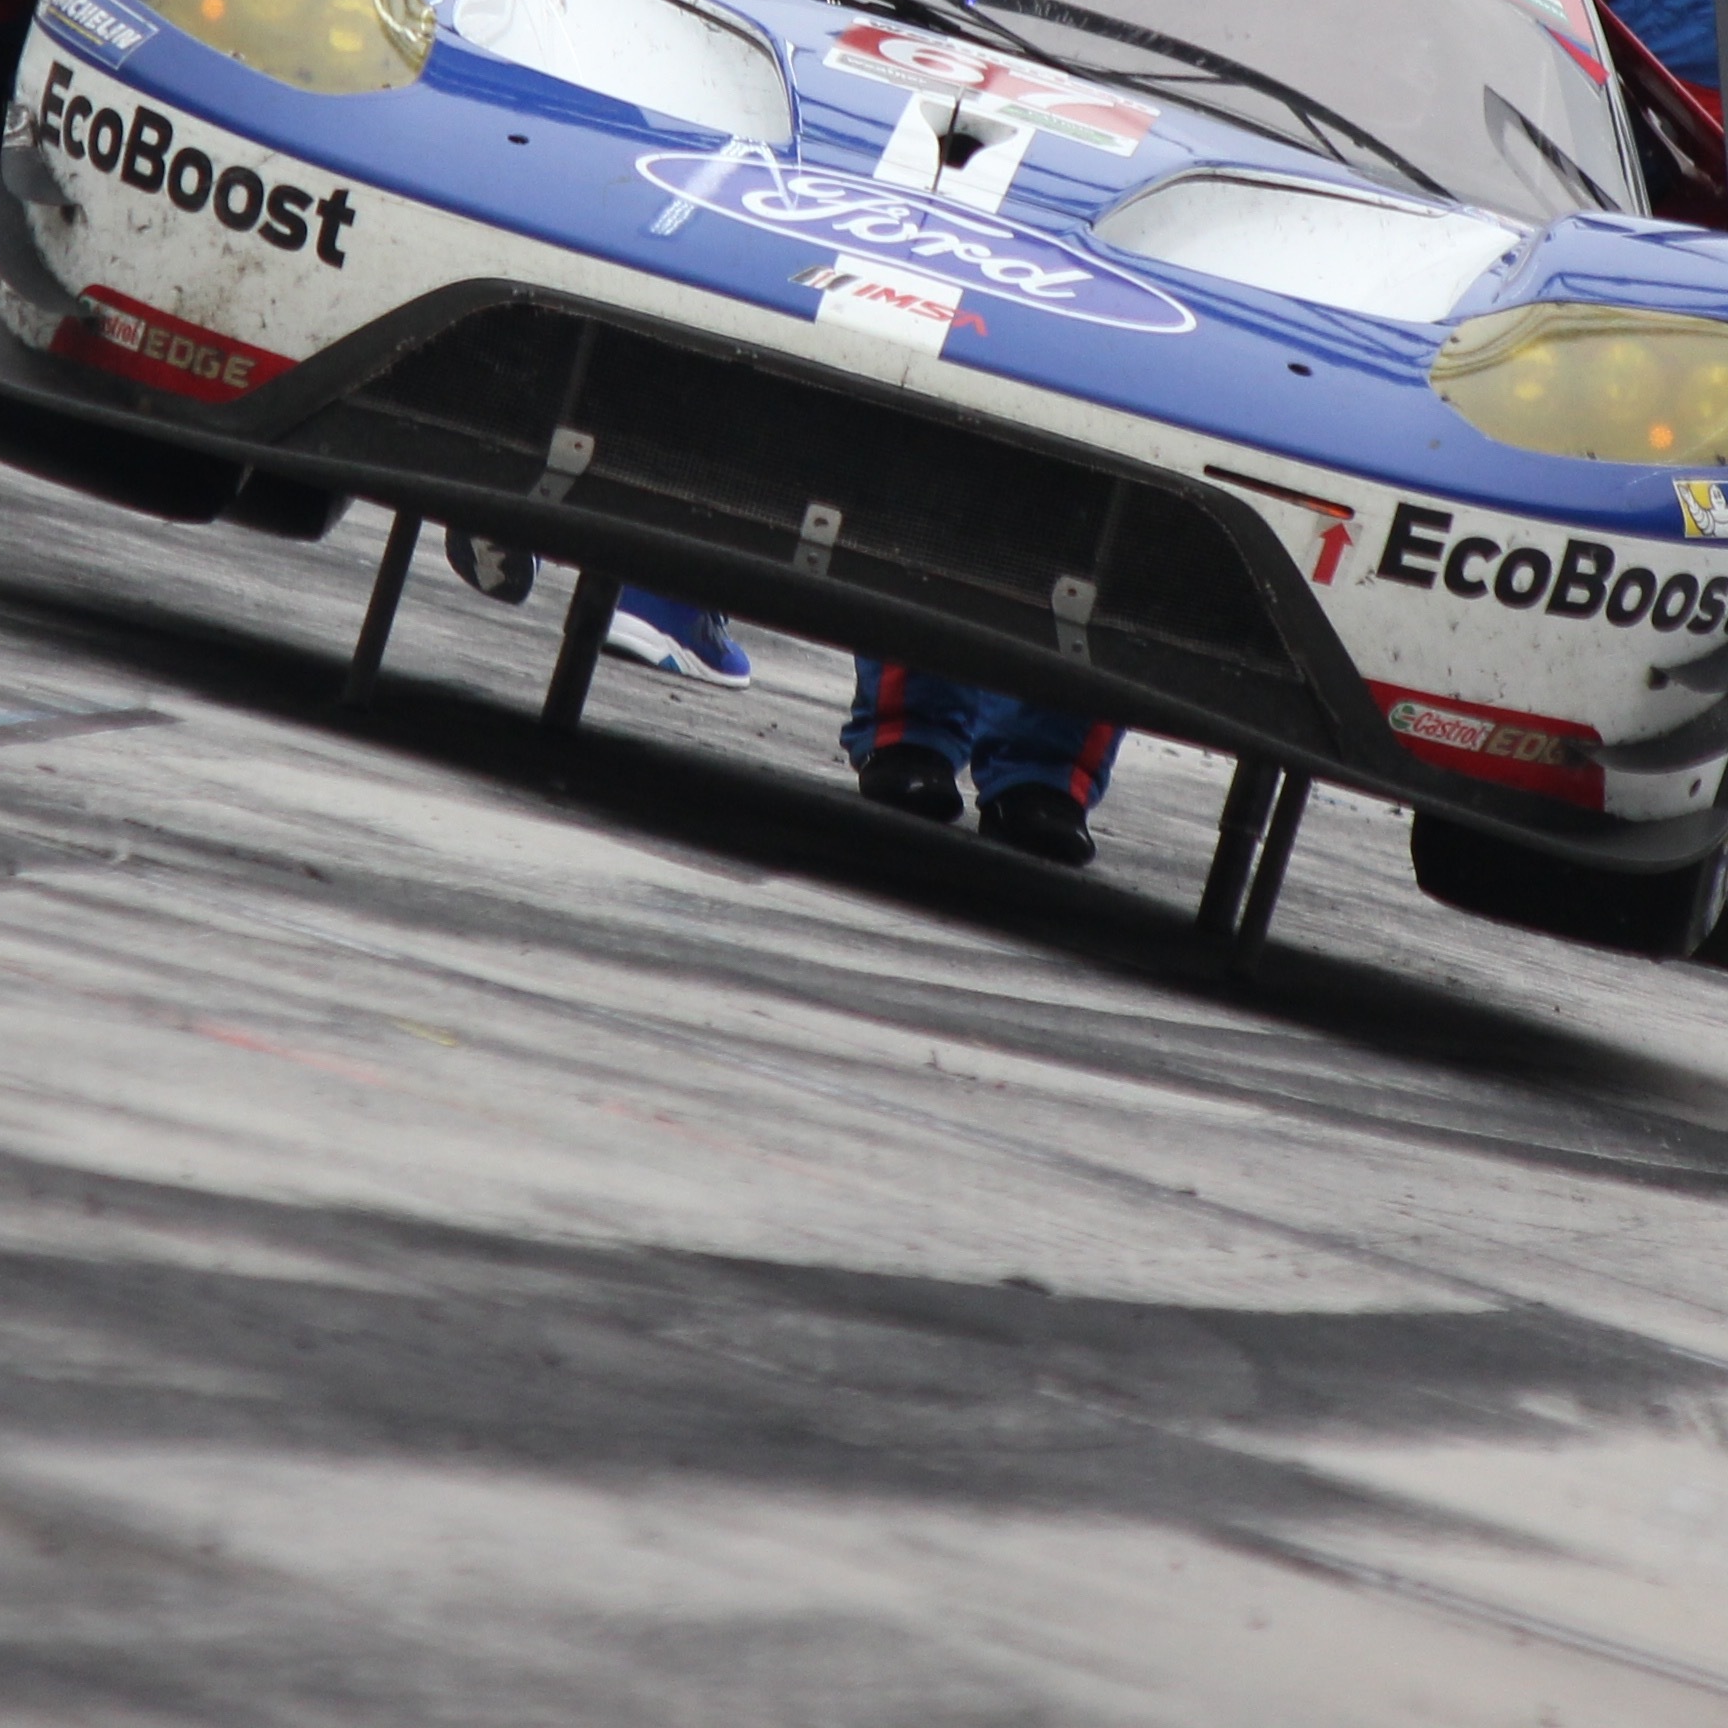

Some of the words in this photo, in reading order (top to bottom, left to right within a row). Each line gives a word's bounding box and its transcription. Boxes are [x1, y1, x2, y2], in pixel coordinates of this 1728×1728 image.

[878, 37, 1117, 110] 67
[36, 60, 357, 271] EcoBoost
[742, 174, 1093, 298] Ford
[853, 282, 989, 337] IMSA
[142, 327, 257, 389] EDGE
[1412, 712, 1486, 751] Castrol
[1486, 726, 1566, 767] EDG
